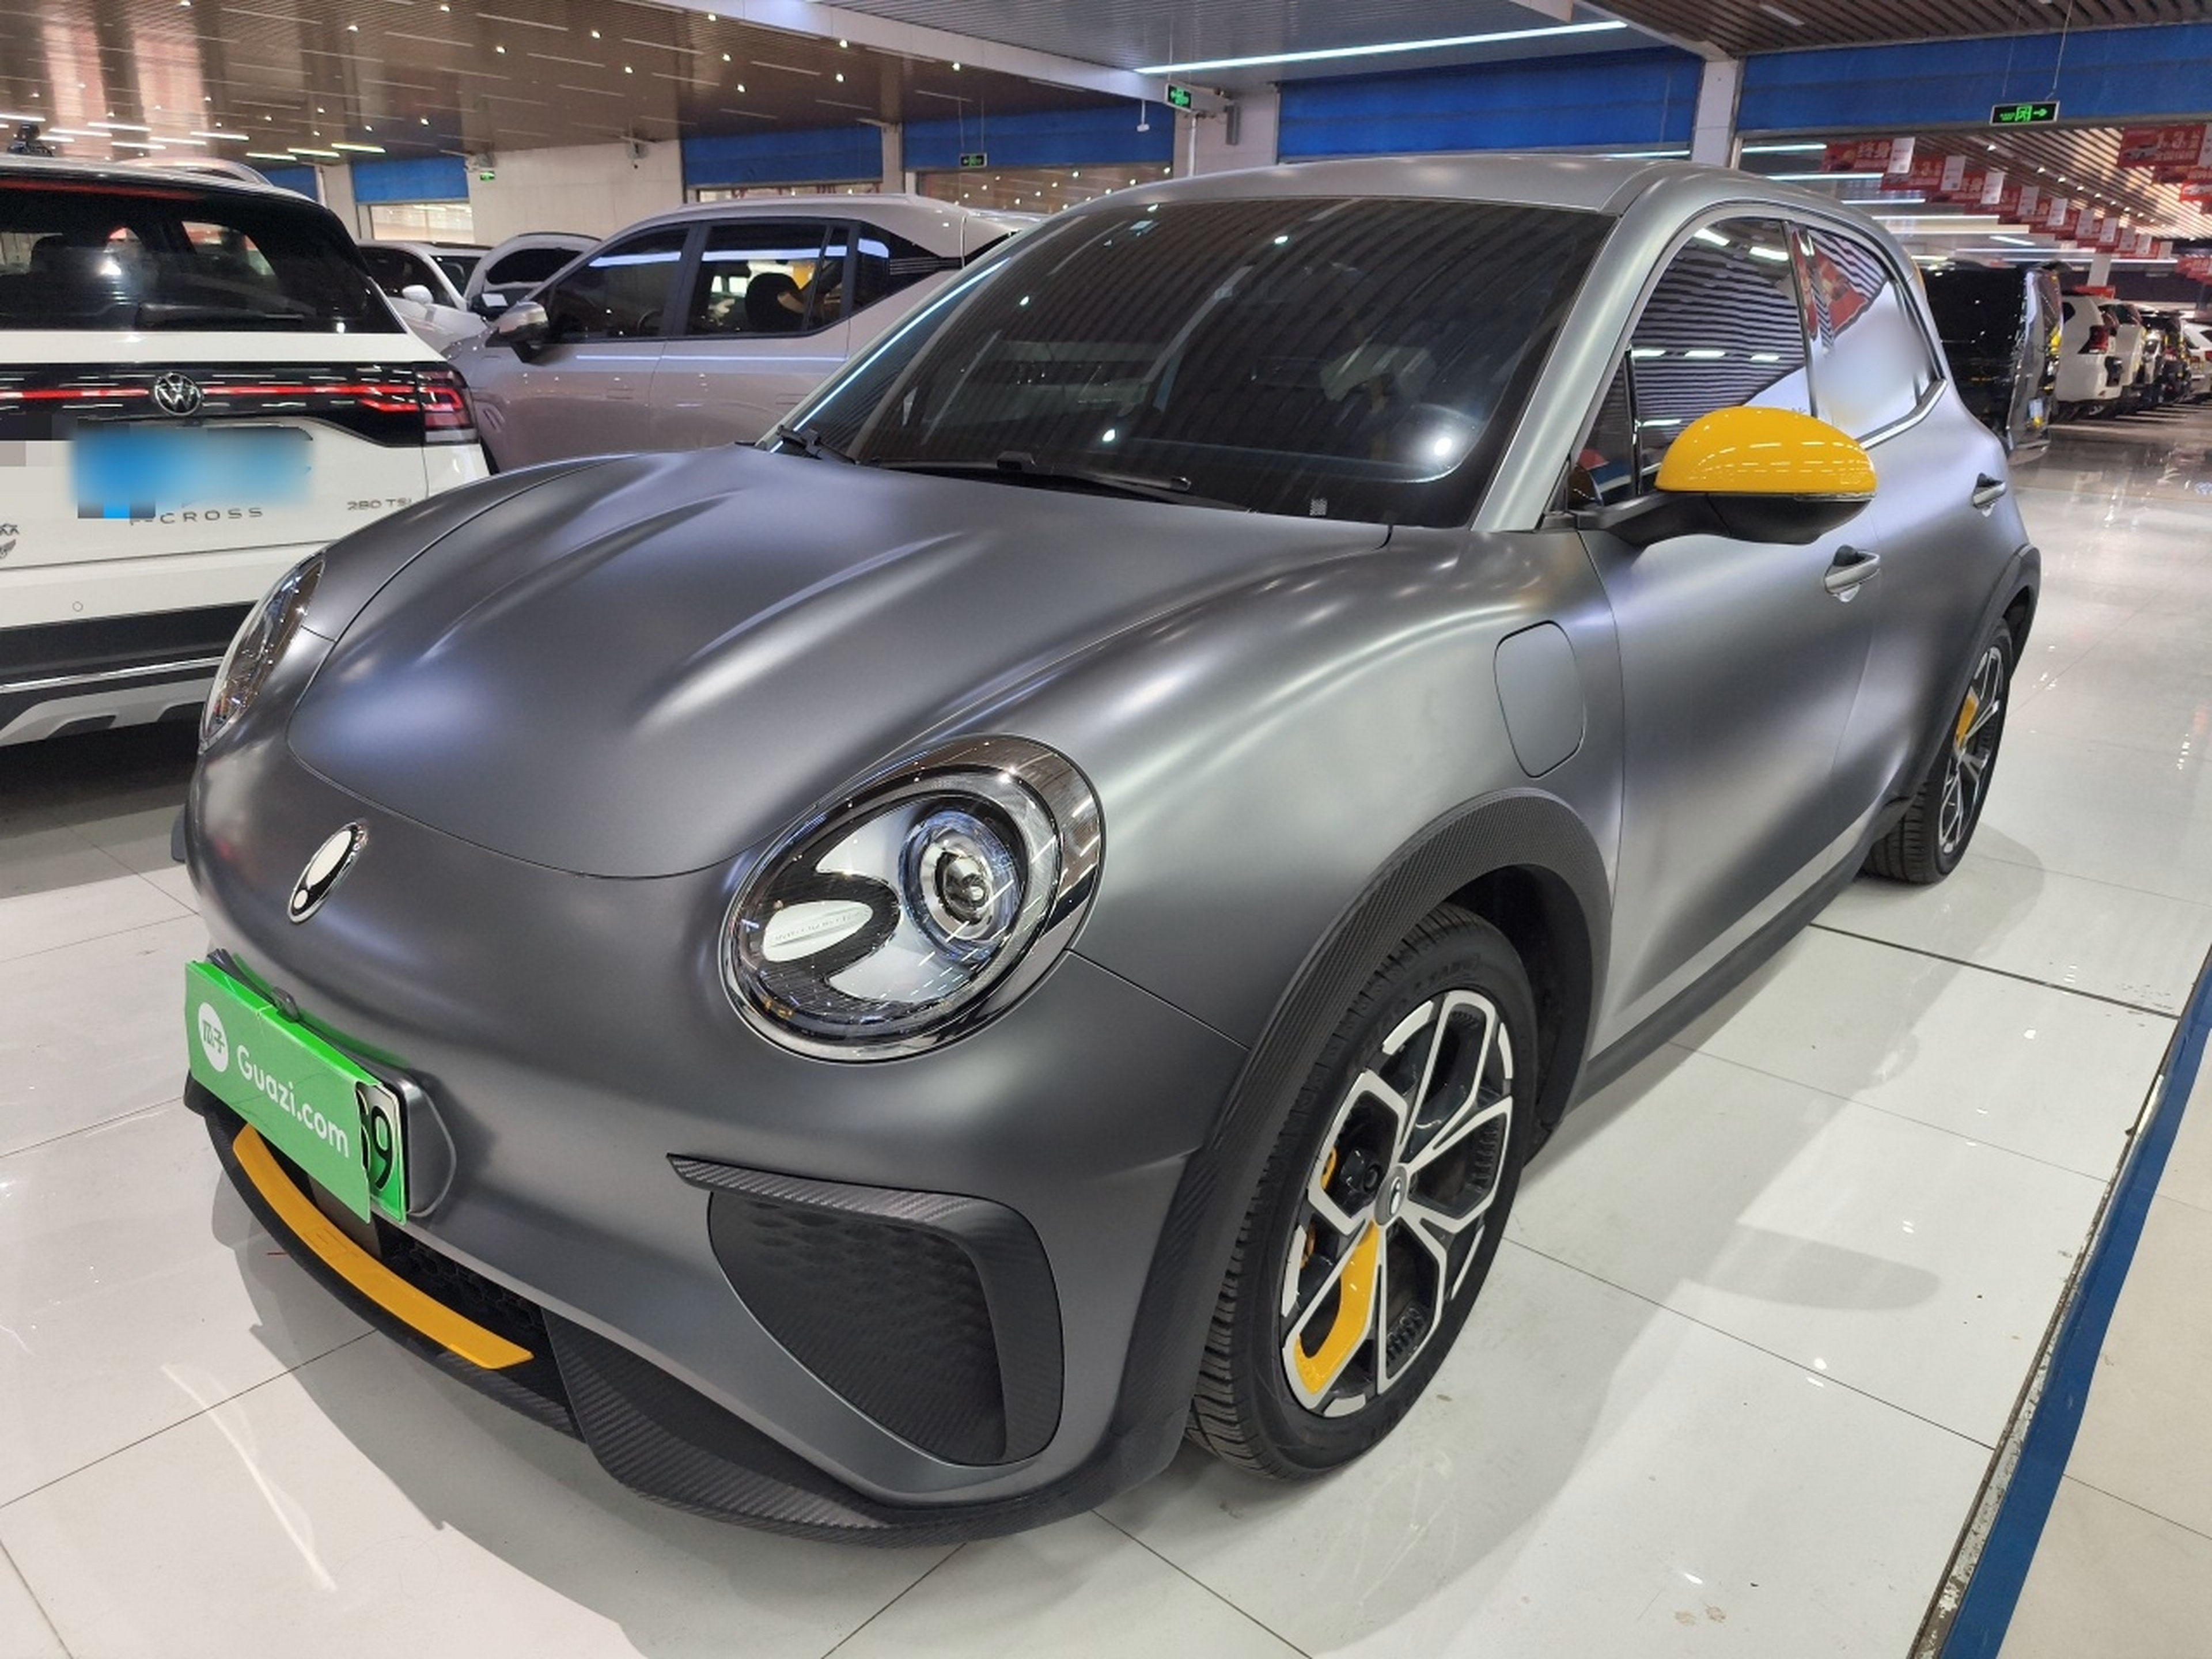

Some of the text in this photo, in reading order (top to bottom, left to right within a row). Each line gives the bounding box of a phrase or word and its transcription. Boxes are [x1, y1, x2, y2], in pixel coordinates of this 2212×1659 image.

[347, 499, 382, 510] 280
[202, 1020, 225, 1054] 瓜子
[237, 1044, 350, 1159] Guazi.com
